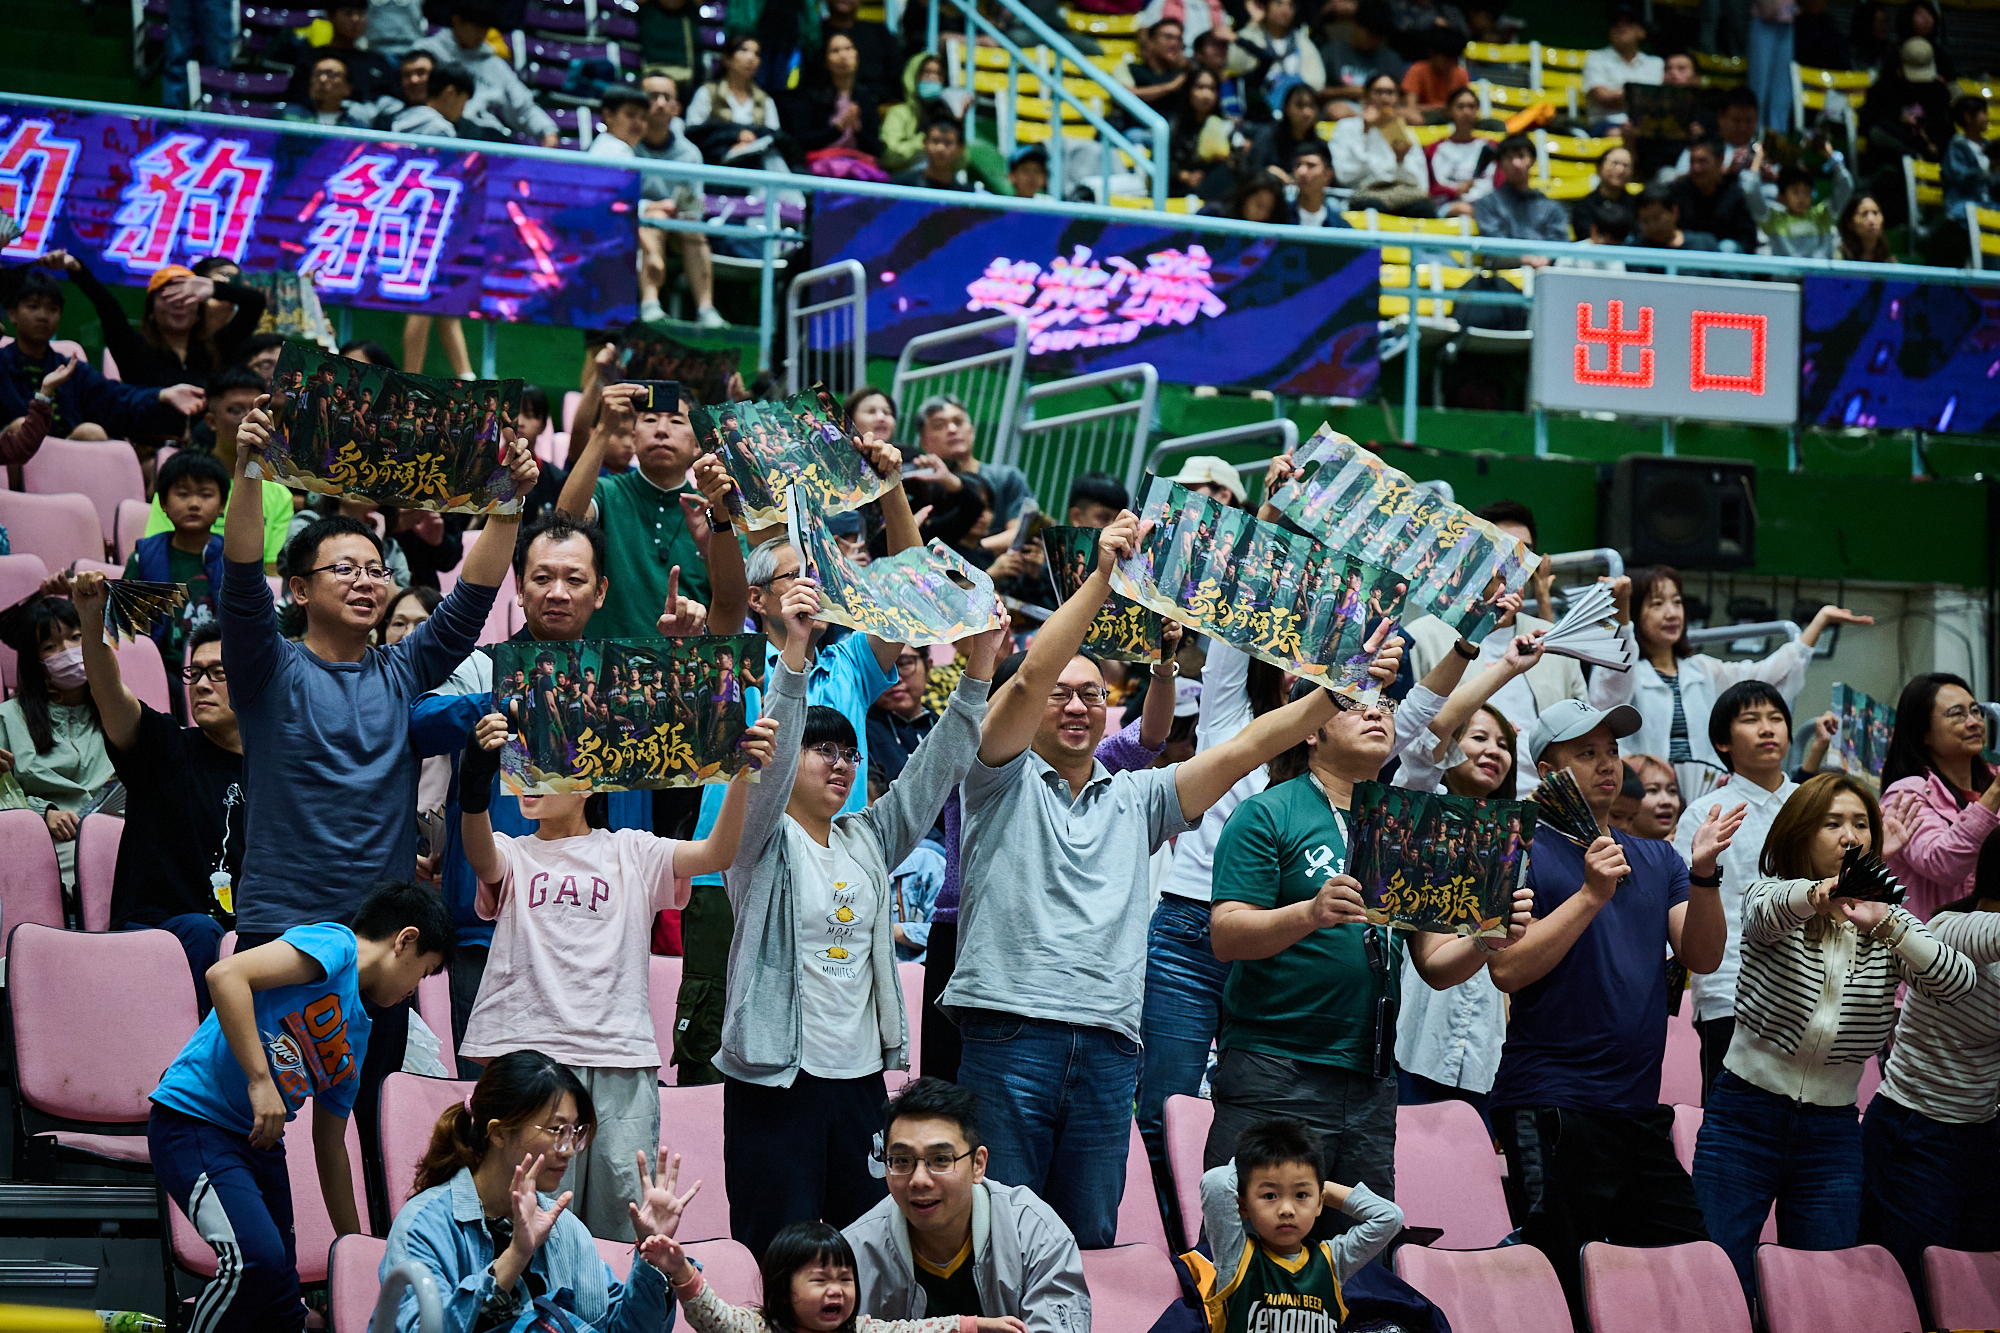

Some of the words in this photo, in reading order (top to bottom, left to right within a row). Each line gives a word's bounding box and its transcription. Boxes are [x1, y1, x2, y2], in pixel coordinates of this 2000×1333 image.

[1573, 299, 1768, 396] 出口
[529, 872, 612, 912] GAP
[832, 890, 856, 904] FIVE
[826, 926, 855, 937] MORE
[822, 966, 856, 979] MINUTES
[269, 1041, 299, 1064] OKC
[1263, 1292, 1301, 1307] TAIWAN
[1303, 1294, 1323, 1311] BEER
